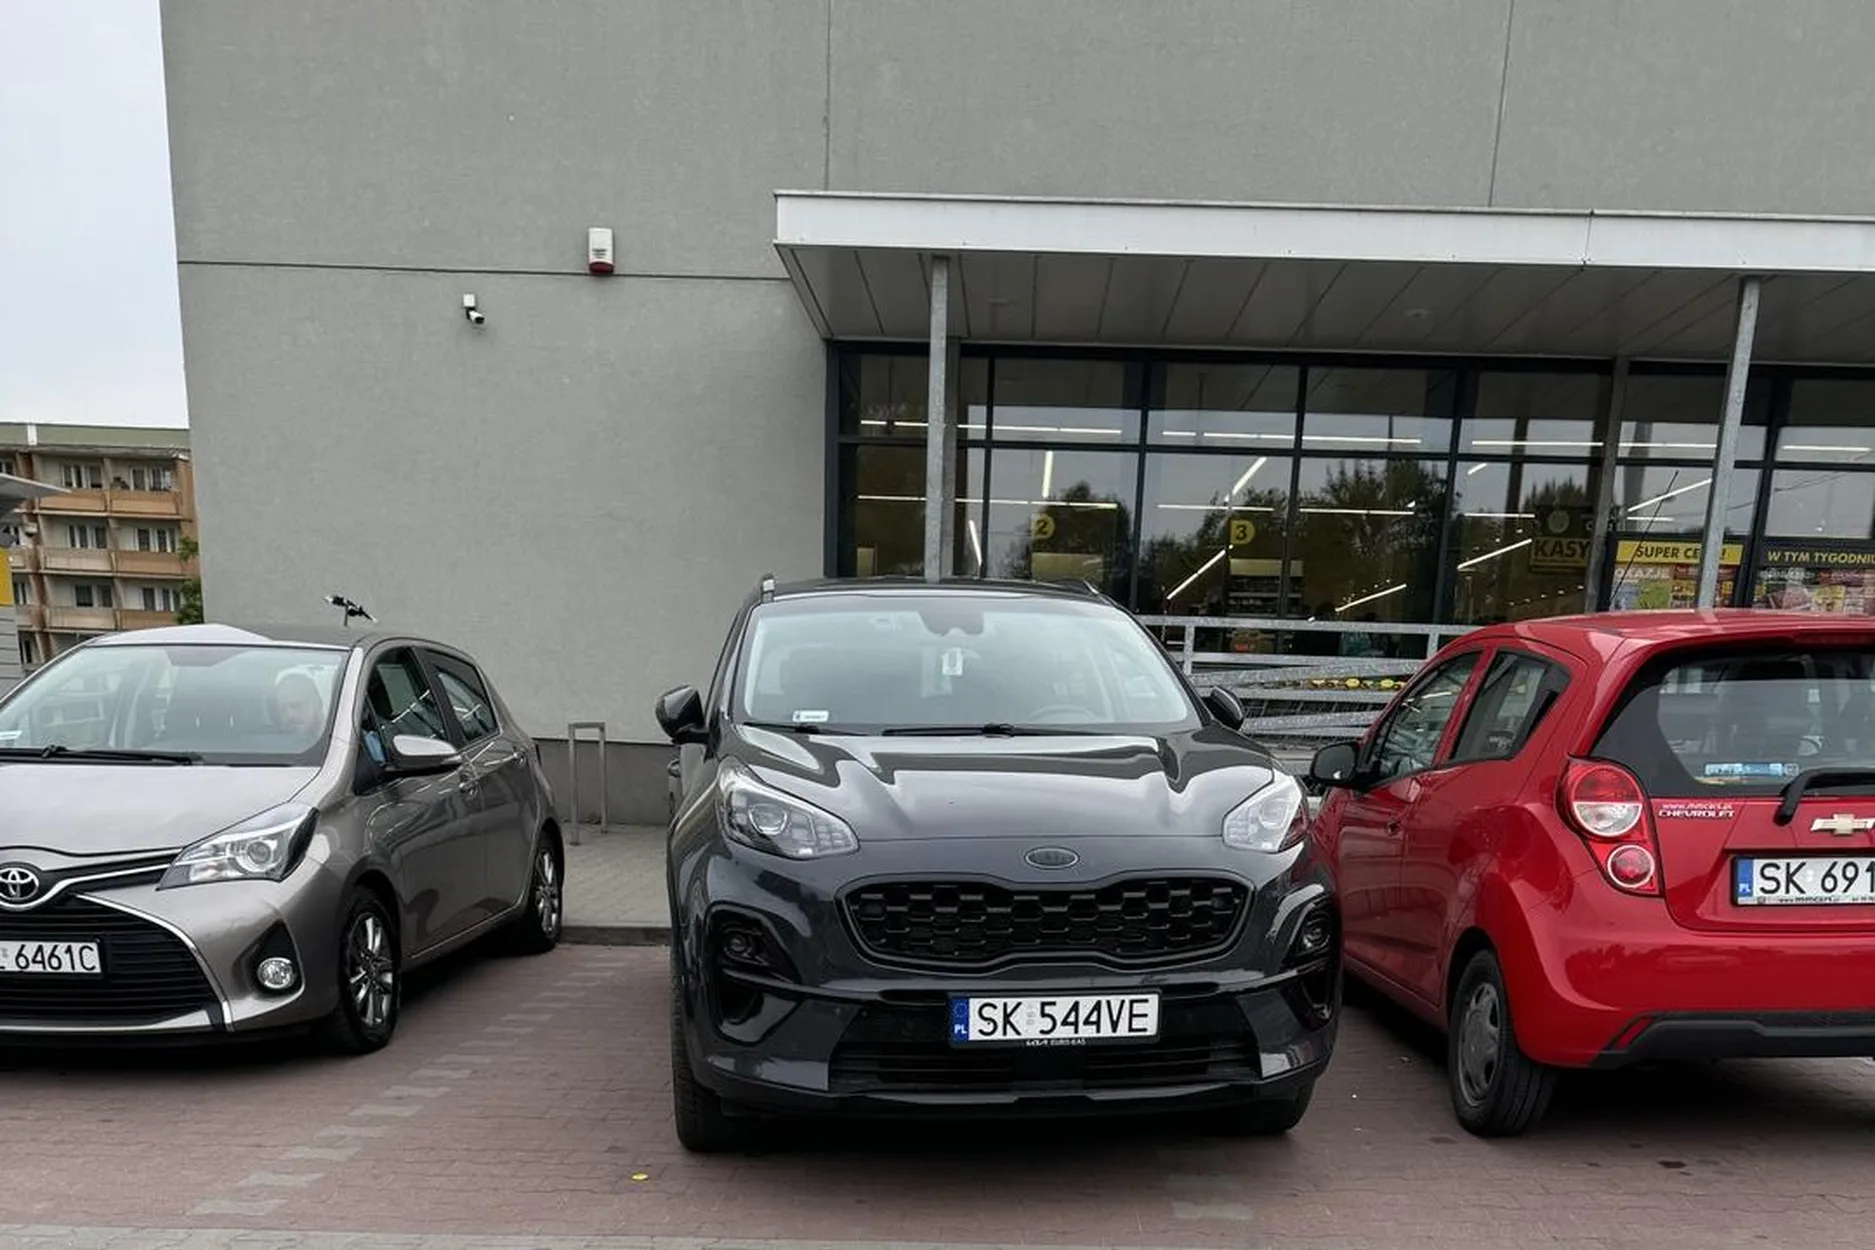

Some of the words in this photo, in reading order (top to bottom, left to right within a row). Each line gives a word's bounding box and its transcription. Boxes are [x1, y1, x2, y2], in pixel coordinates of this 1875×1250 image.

[1036, 519, 1048, 535] 2
[1235, 524, 1248, 541] 3
[1534, 541, 1590, 558] KASY
[1636, 546, 1679, 559] SUPER
[1768, 551, 1781, 561] W
[1784, 551, 1810, 563] TYM
[1659, 810, 1735, 818] CHEVROLET
[1760, 862, 1807, 894] SK
[1739, 883, 1751, 892] PL
[15, 944, 96, 971] 6461C
[977, 1002, 1022, 1037] SK
[1039, 999, 1150, 1035] 544VE
[954, 1024, 968, 1035] PL
